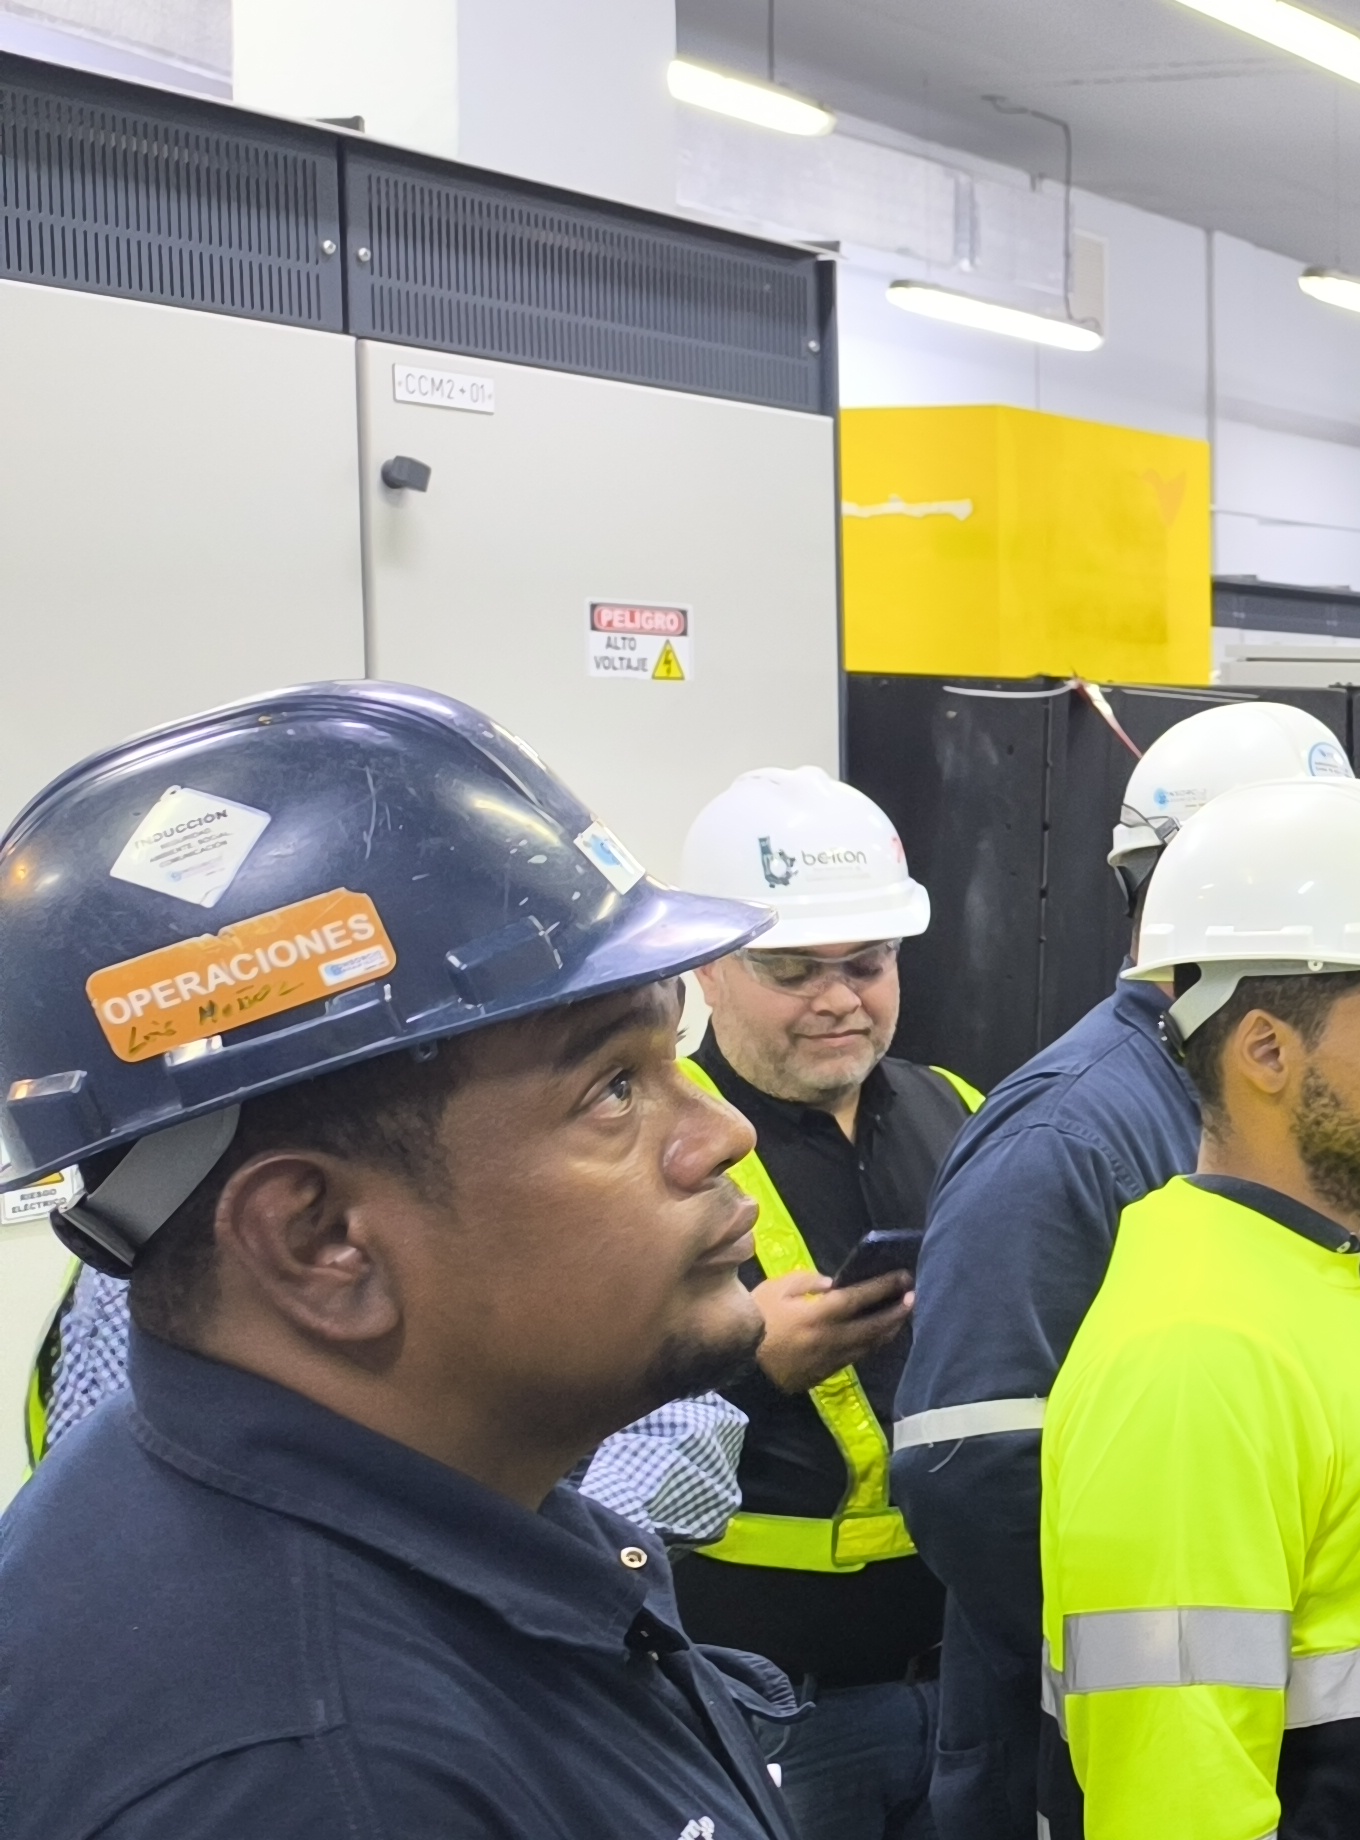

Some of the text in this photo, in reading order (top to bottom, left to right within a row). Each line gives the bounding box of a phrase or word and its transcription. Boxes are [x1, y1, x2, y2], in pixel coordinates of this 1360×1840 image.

[600, 608, 679, 631] PELIGRO
[605, 636, 637, 651] ALTO
[594, 655, 648, 672] VOLTAJE
[102, 913, 376, 1025] OPERACIONES
